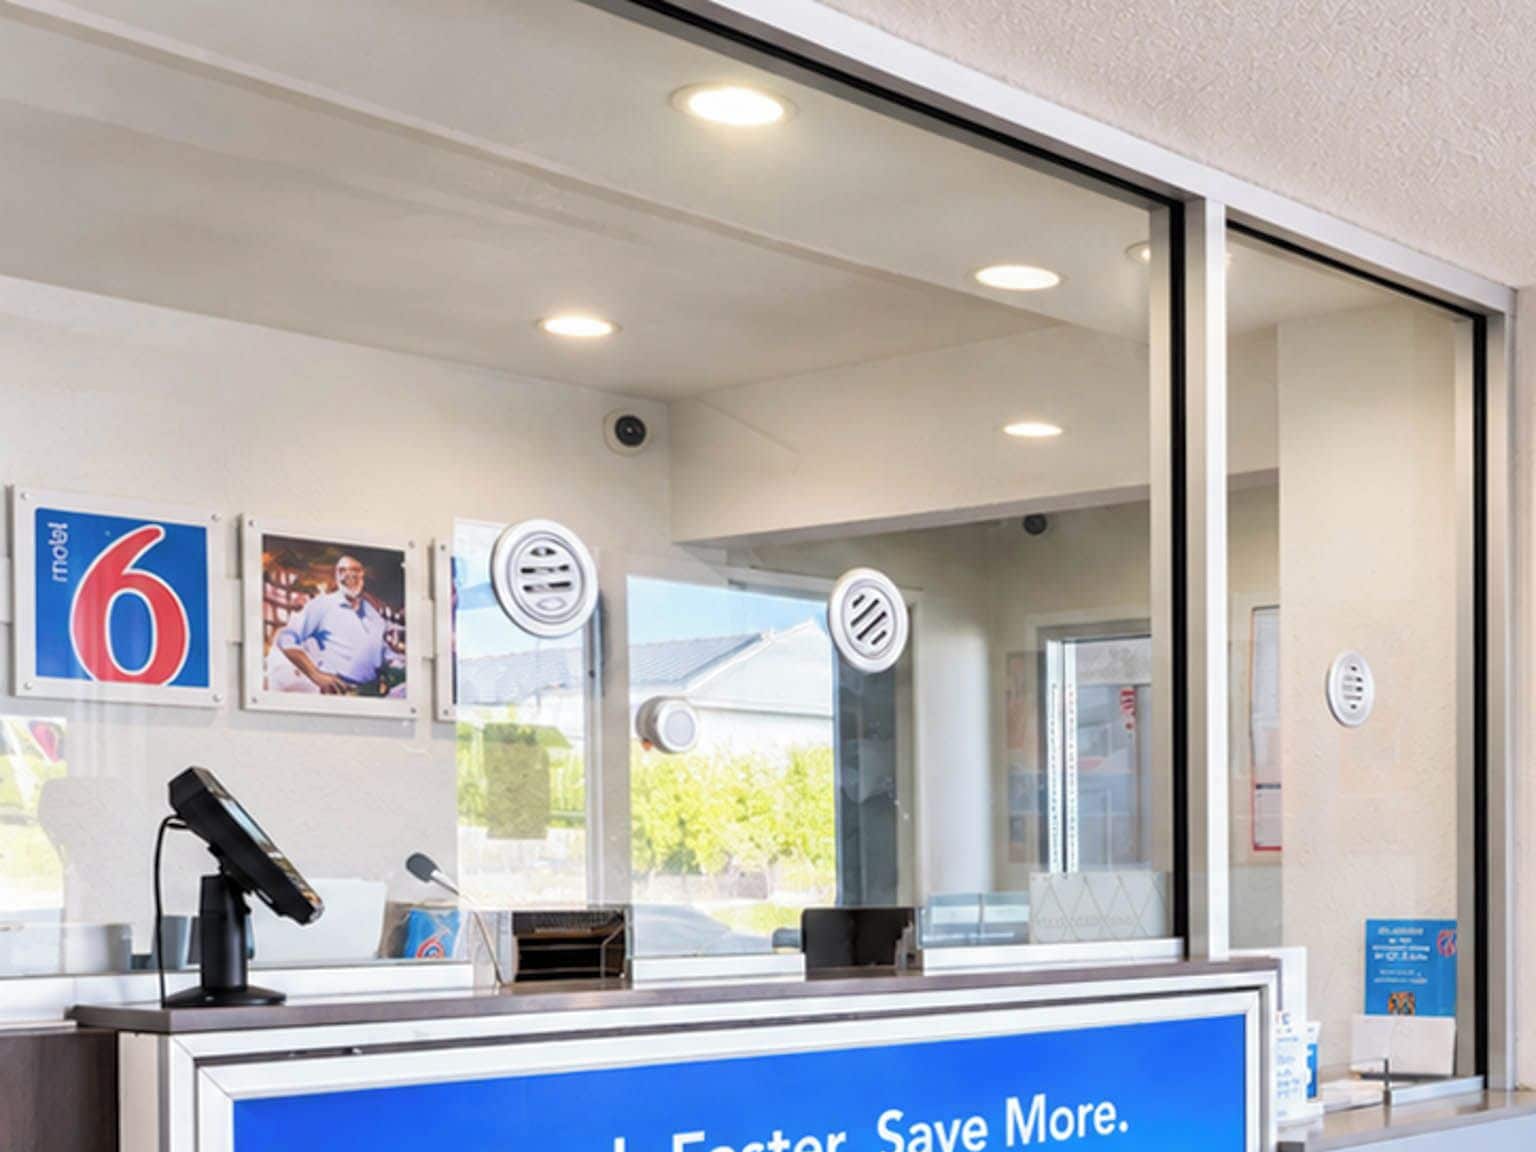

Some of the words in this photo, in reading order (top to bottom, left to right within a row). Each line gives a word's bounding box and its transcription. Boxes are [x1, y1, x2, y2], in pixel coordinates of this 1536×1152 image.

[48, 522, 69, 583] motel
[69, 524, 191, 685] 6
[1005, 1093, 1129, 1147] More.
